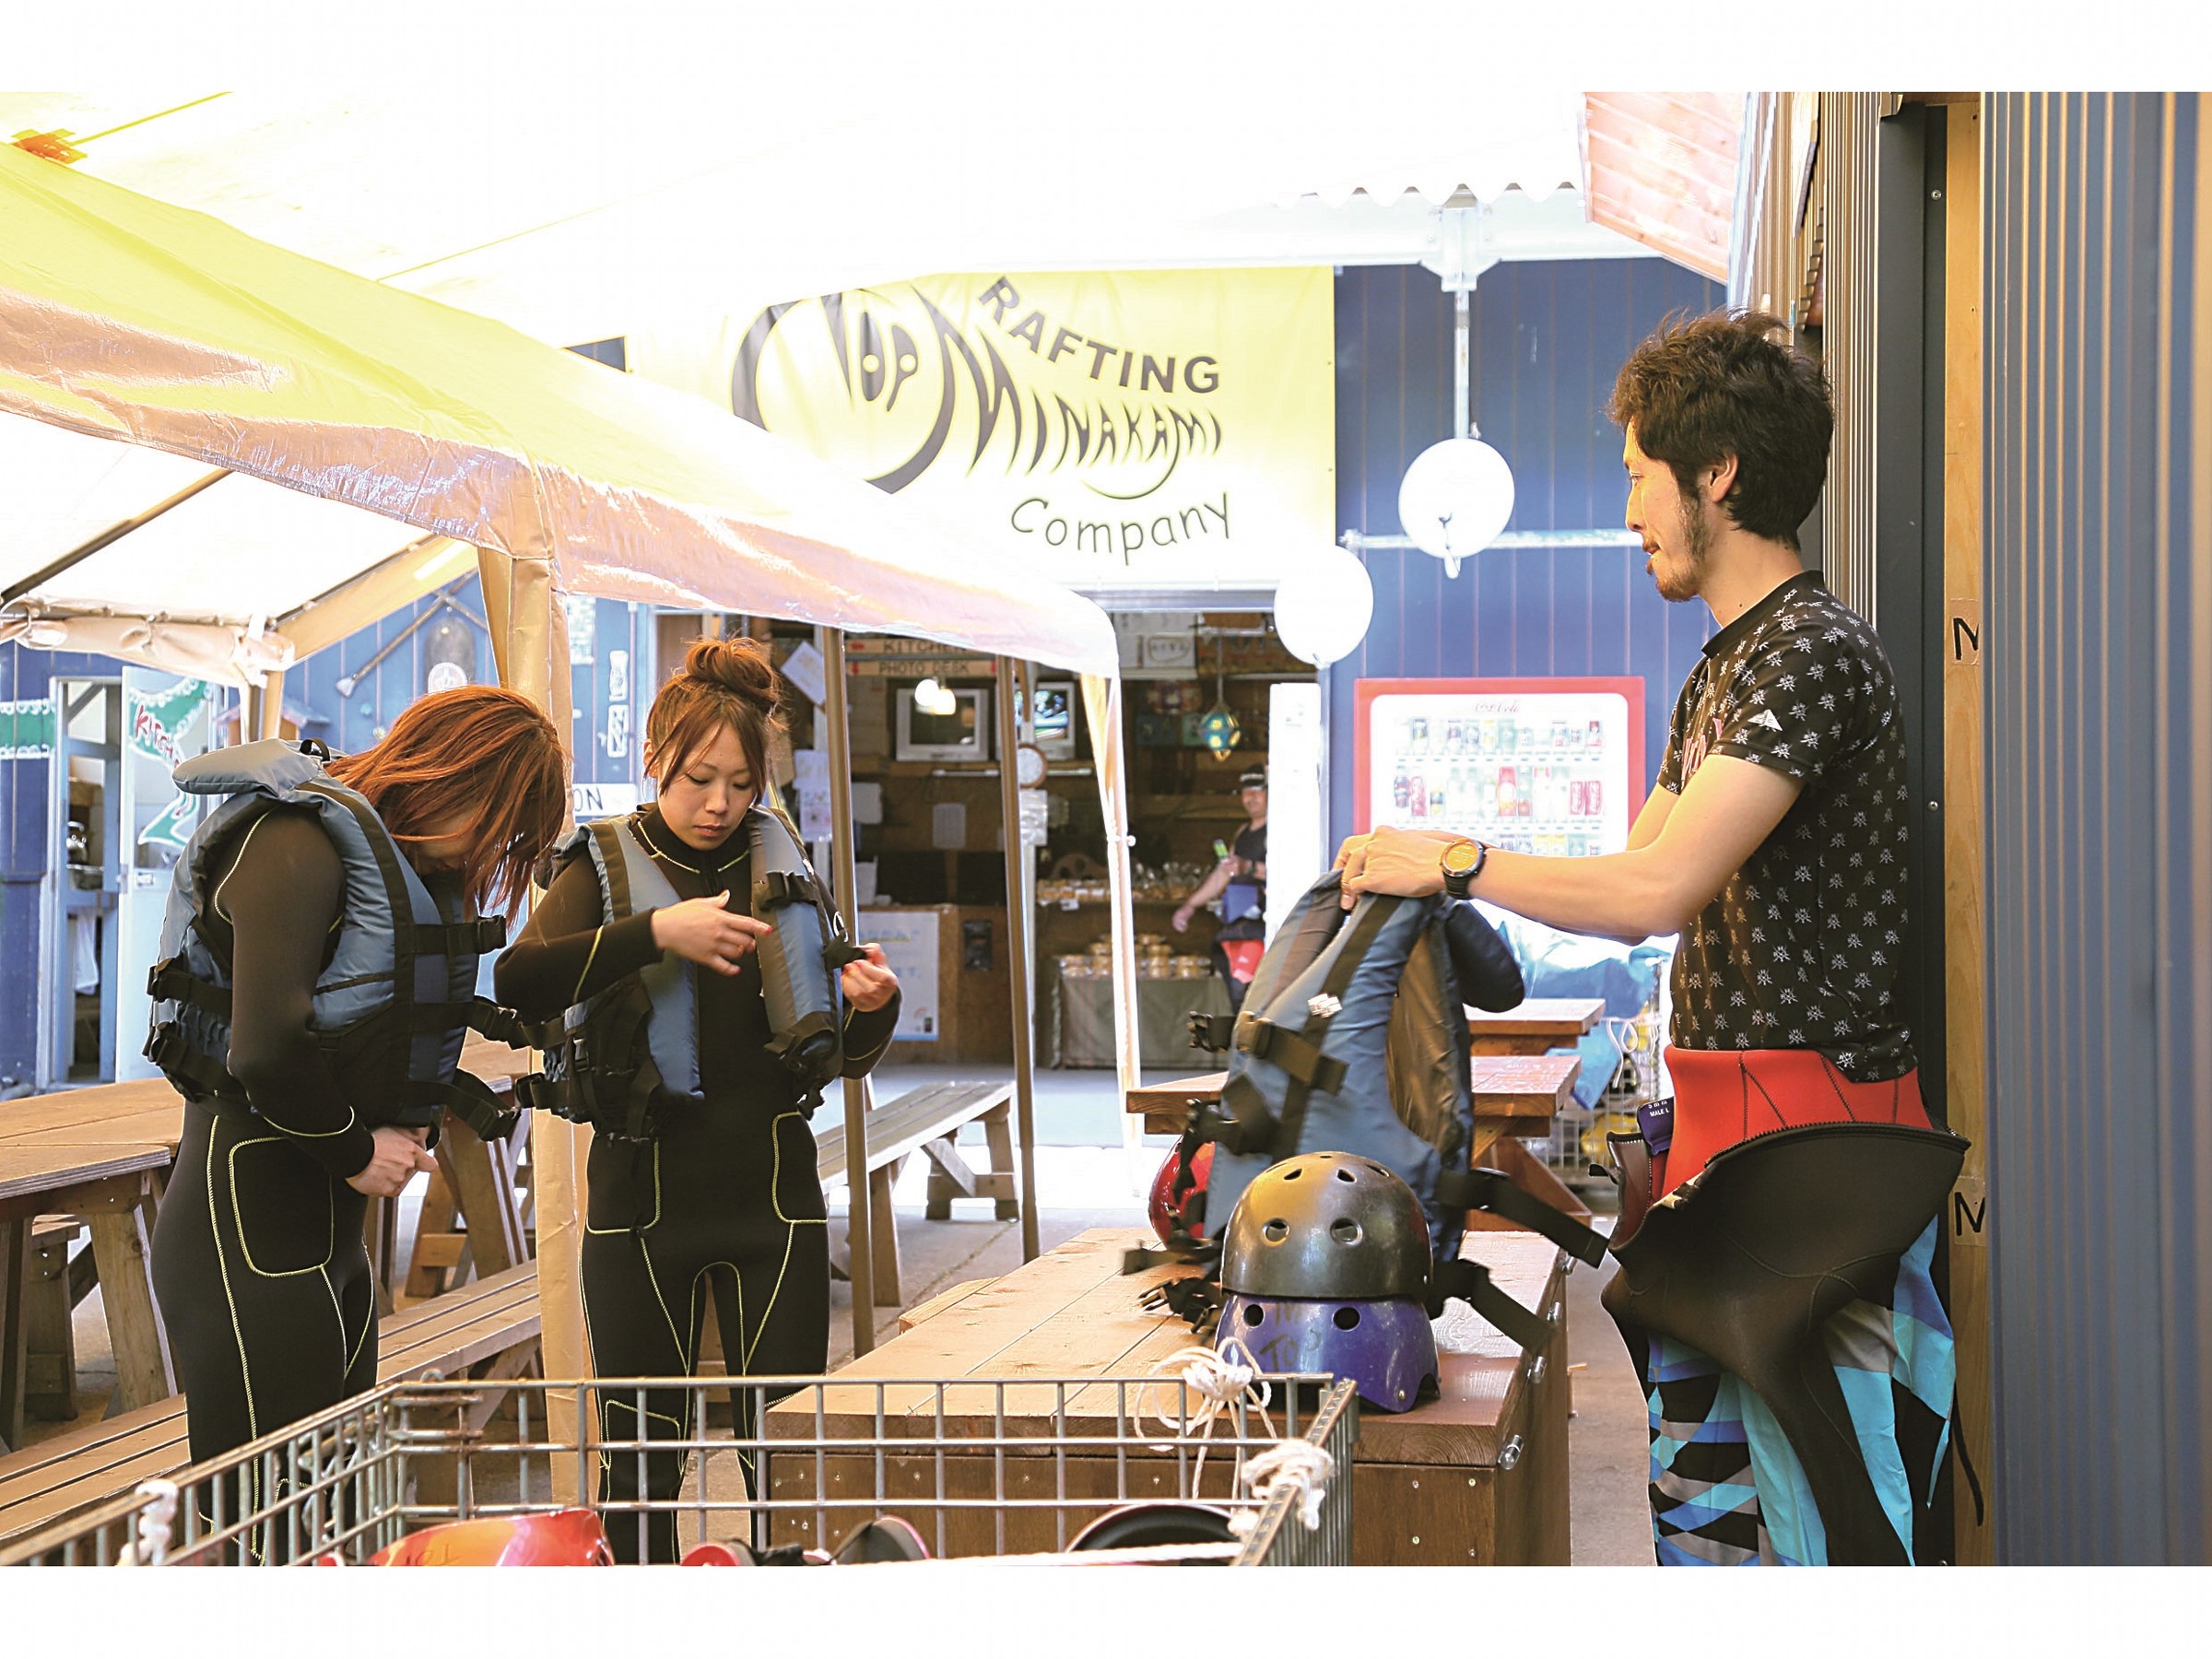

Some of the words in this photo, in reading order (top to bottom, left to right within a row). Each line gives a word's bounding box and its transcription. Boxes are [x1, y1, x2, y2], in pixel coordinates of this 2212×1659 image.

[977, 276, 1220, 394] RAFTING
[922, 297, 1222, 493] MINAKAMI
[1010, 492, 1231, 567] Company
[879, 661, 925, 675] PHOTO
[933, 661, 970, 675] DESK
[1649, 1109, 1665, 1117] MALE
